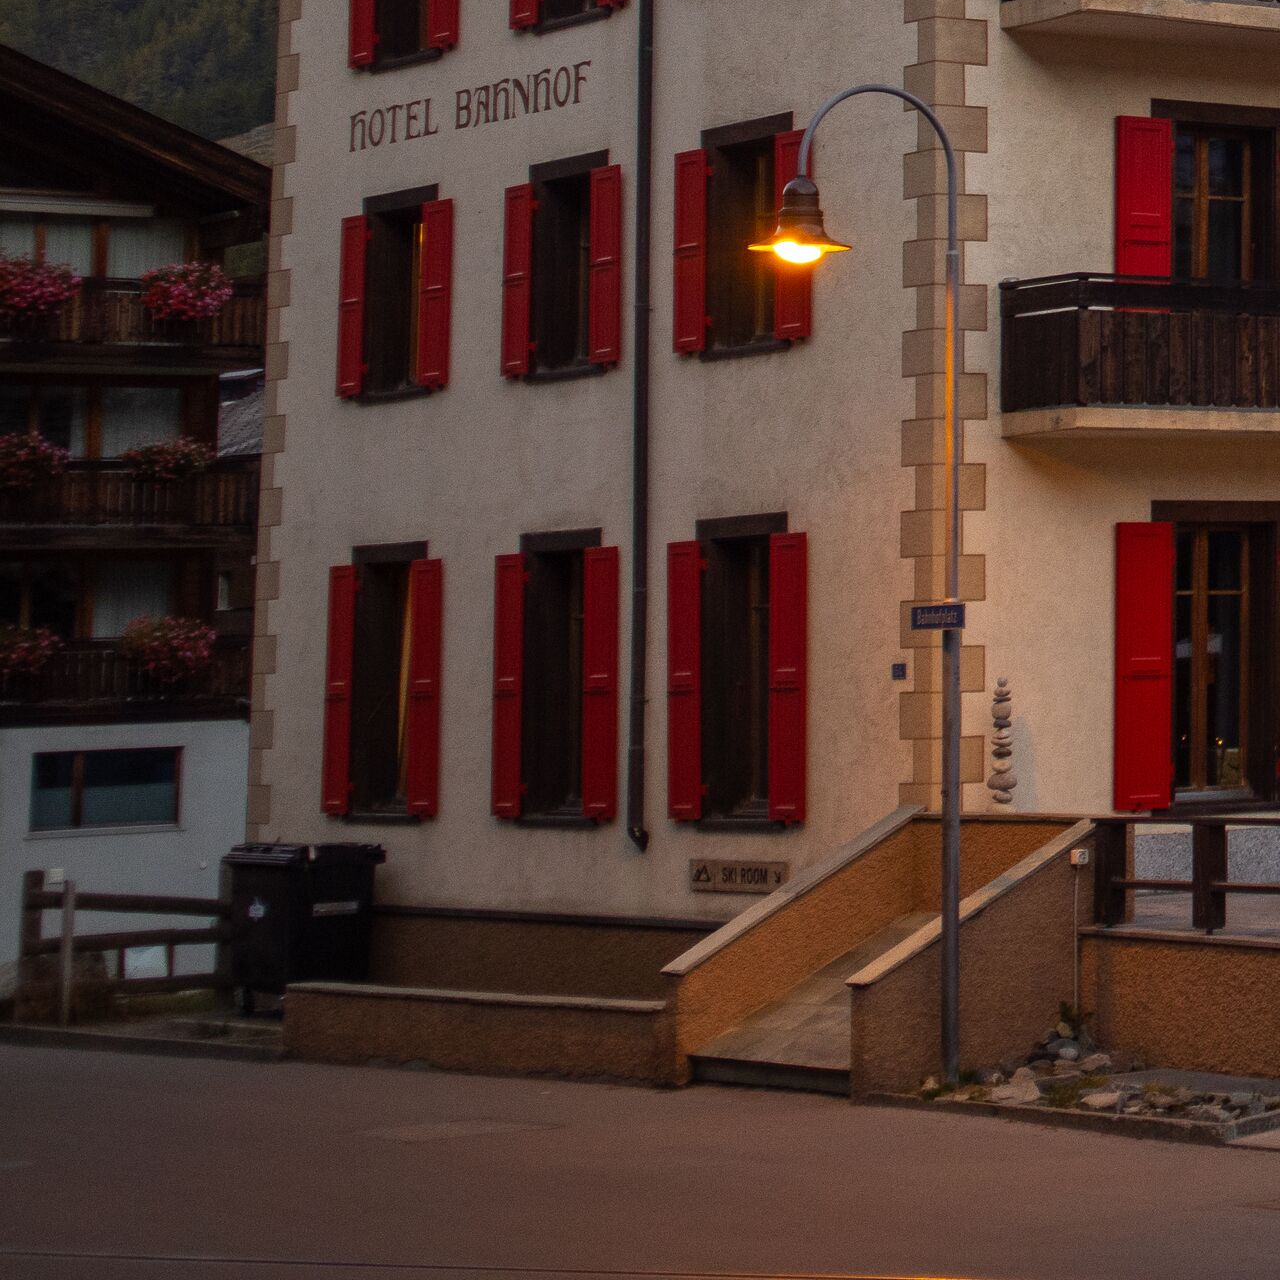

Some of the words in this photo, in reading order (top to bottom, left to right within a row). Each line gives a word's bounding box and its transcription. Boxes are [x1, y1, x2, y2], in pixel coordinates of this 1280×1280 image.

[349, 98, 438, 153] HOTEL
[455, 61, 592, 130] BAHNHOF
[722, 866, 738, 884] SKI
[740, 866, 768, 885] ROOM
